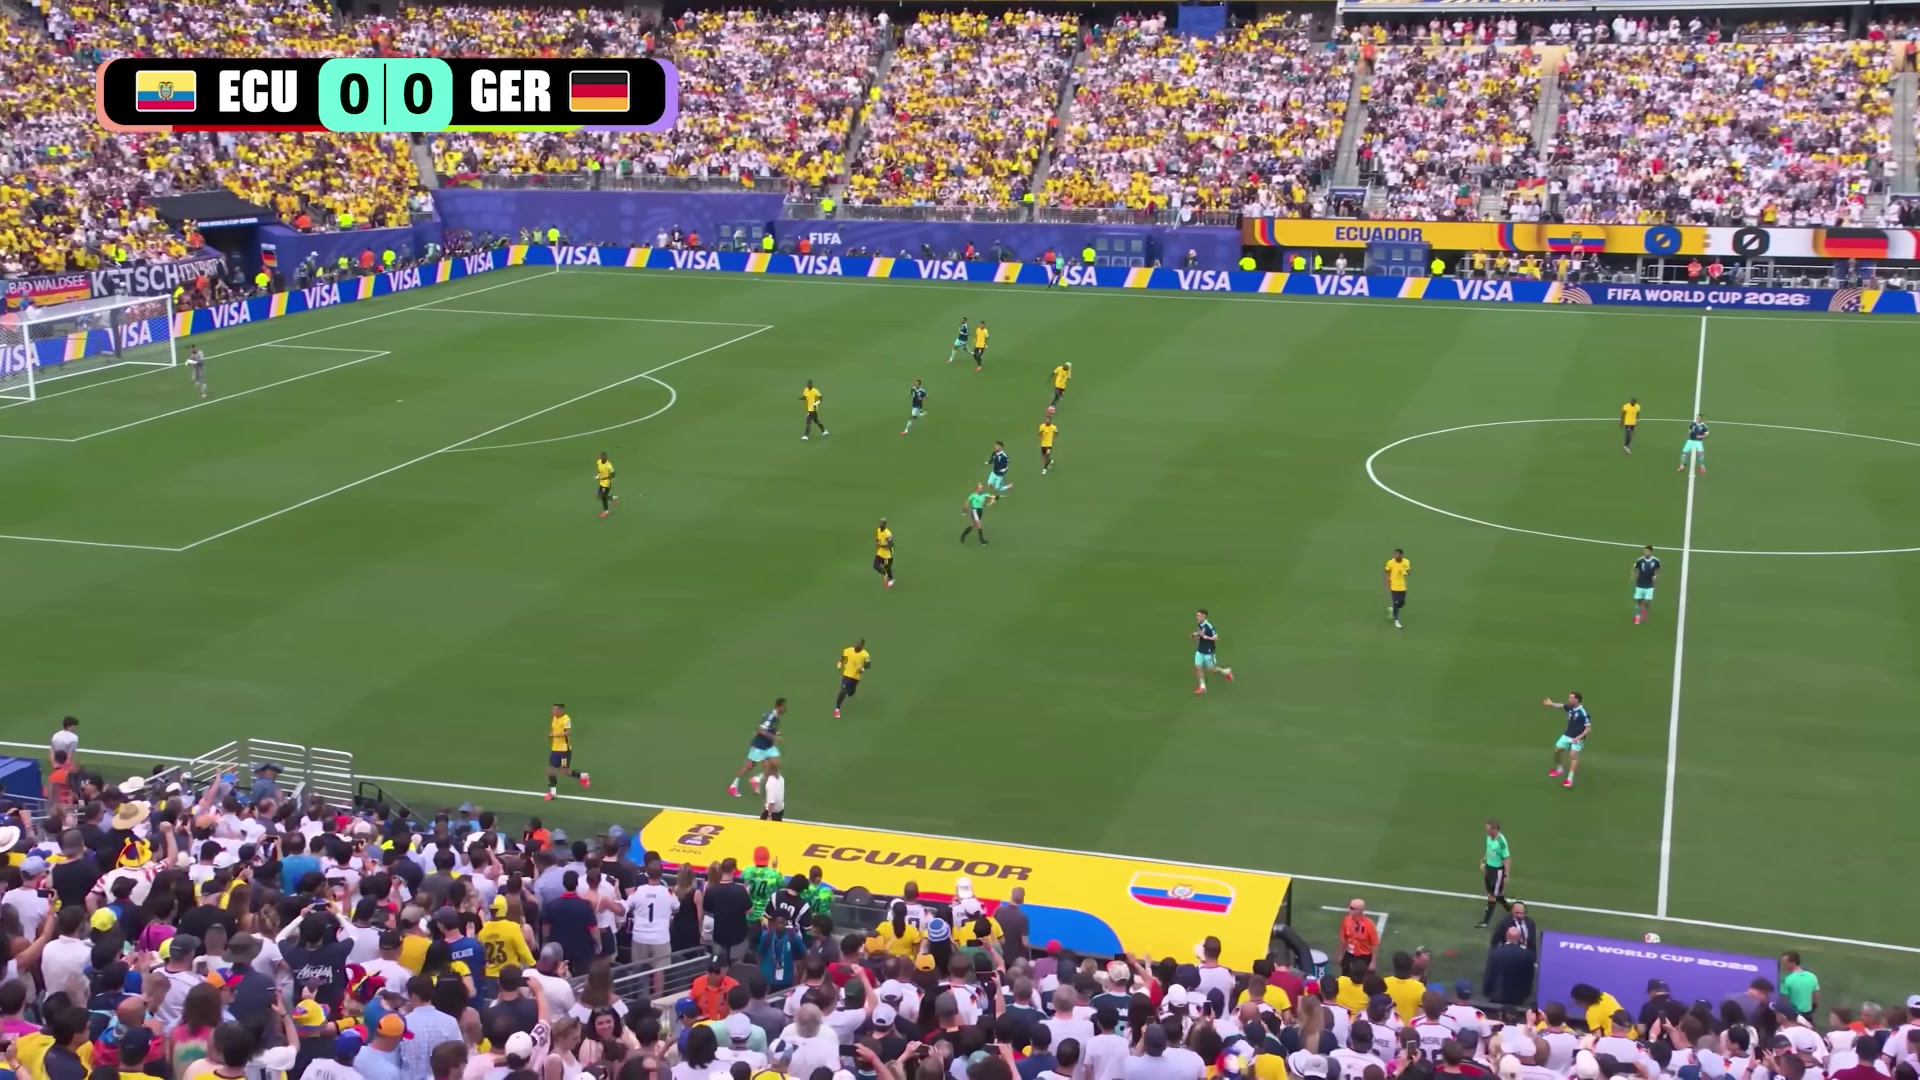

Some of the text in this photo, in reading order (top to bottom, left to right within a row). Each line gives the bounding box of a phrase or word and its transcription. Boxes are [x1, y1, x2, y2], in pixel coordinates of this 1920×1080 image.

[808, 232, 842, 246] FIFA
[1335, 225, 1423, 242] ECUADOR
[462, 247, 494, 276] VISA
[549, 246, 602, 267] VISA
[668, 249, 722, 271] VISA
[789, 254, 844, 277] VISA
[90, 264, 180, 297] KETSCH
[386, 261, 423, 292] VISA
[914, 258, 969, 281] VISA
[1173, 268, 1232, 293] VISA
[8, 275, 86, 295] BAD WALDSEE
[302, 282, 342, 311] VISA
[1310, 273, 1371, 298] VISA
[1452, 278, 1515, 302] VISA
[1607, 287, 1641, 301] FIFA
[1643, 289, 1706, 303] WORLD
[1707, 291, 1743, 304] CUP
[1744, 292, 1805, 306] 2026
[208, 301, 251, 330] VISA
[106, 319, 153, 349] VISA
[802, 843, 1033, 881] ECUADOR
[647, 902, 654, 923] 1
[484, 940, 508, 965] 23
[1559, 941, 1760, 973] FIFA WORLD CUP 2026
